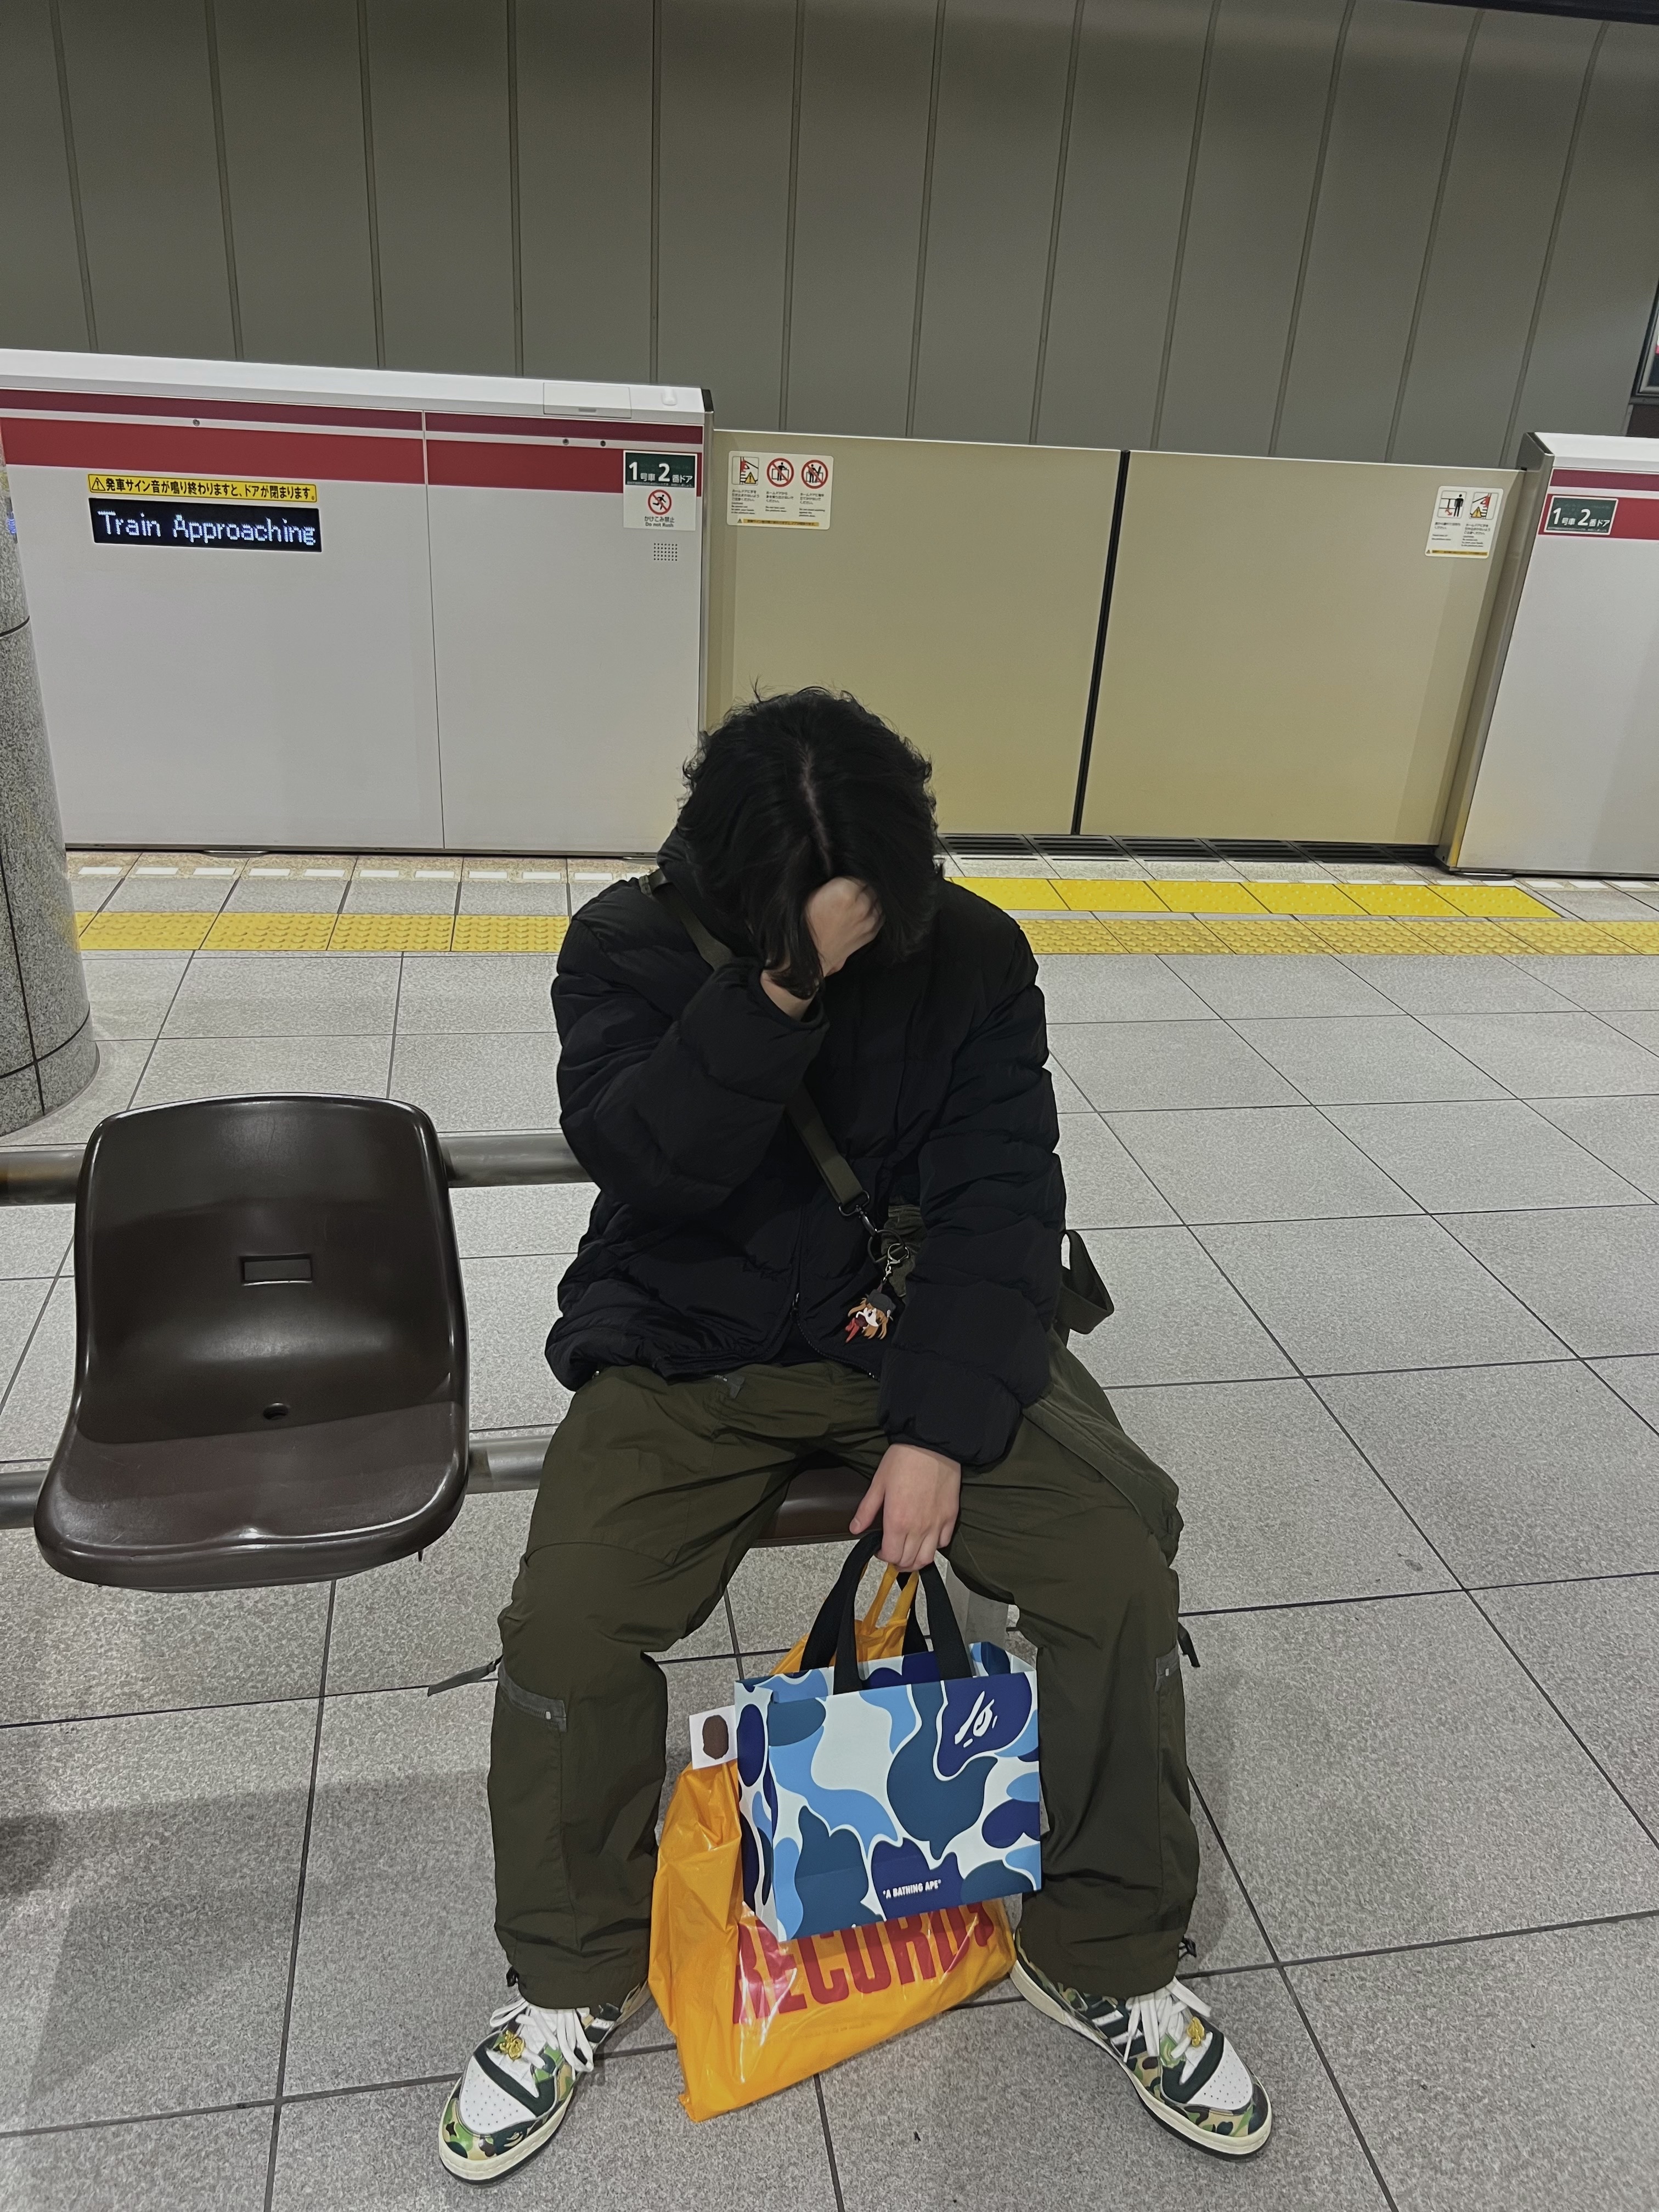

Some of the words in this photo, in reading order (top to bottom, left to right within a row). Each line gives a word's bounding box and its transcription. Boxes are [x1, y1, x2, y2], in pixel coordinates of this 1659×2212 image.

[98, 511, 161, 537] Train
[172, 514, 315, 546] Approaching
[893, 1883, 923, 1897] BATHING
